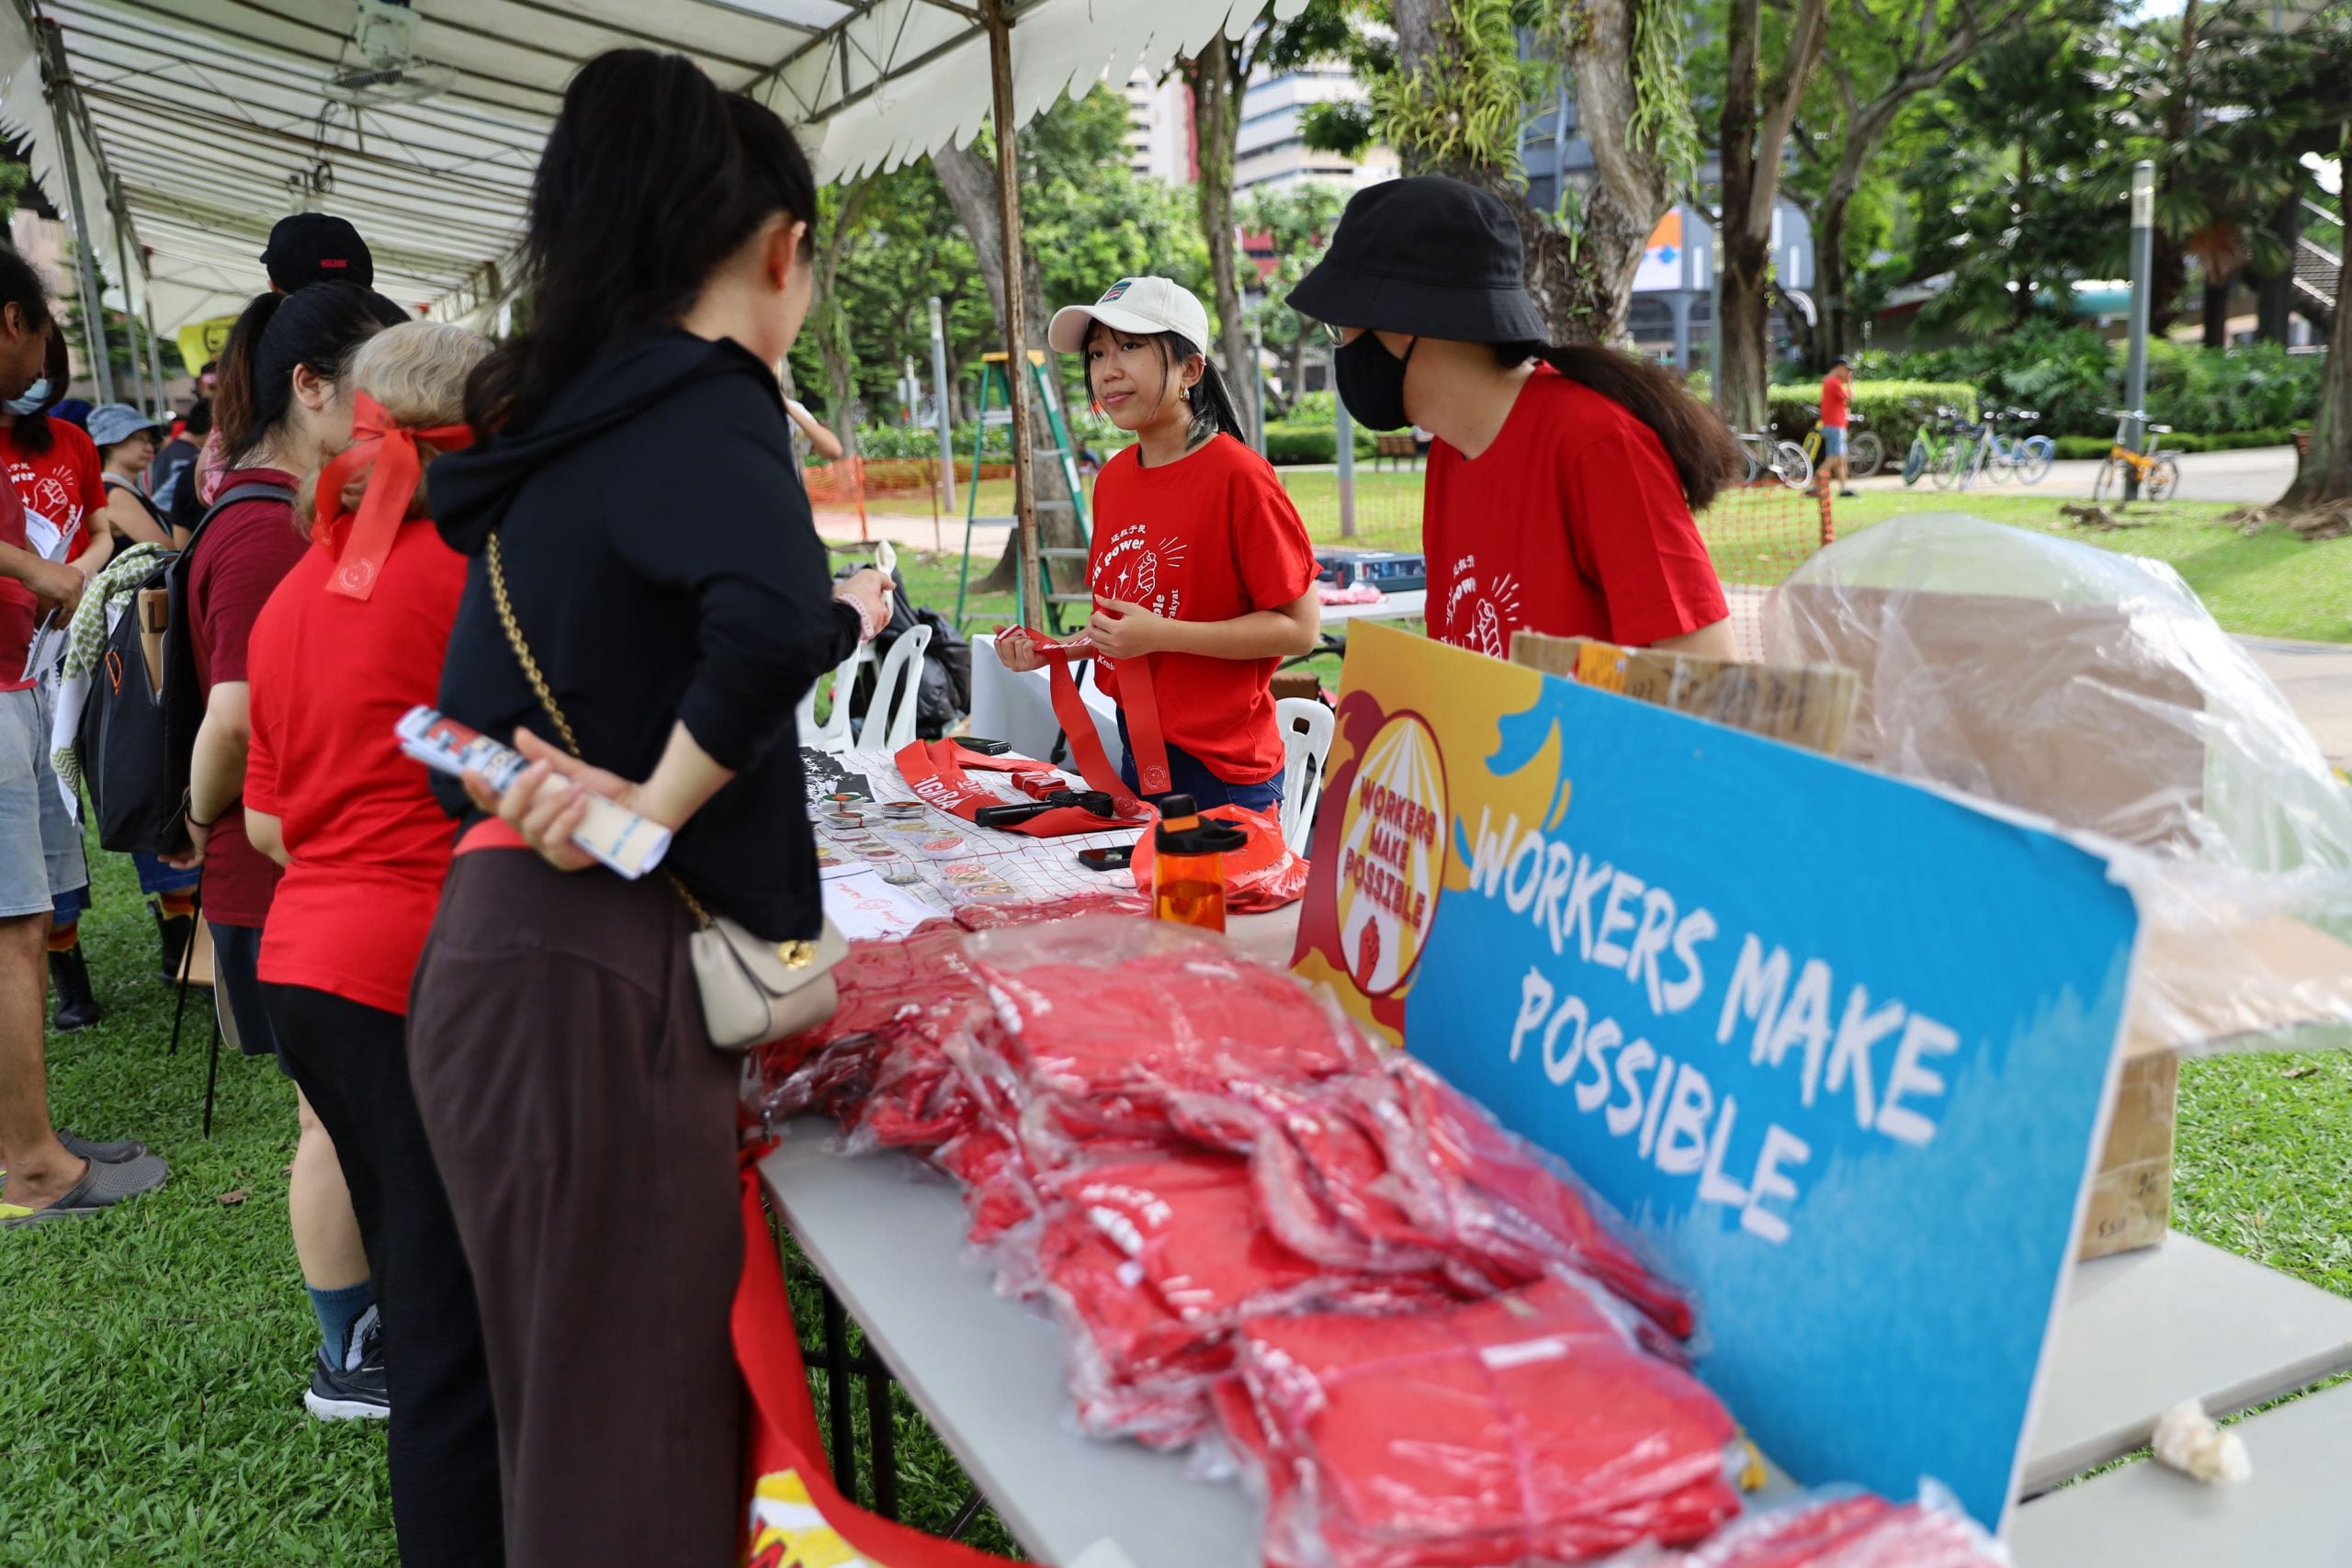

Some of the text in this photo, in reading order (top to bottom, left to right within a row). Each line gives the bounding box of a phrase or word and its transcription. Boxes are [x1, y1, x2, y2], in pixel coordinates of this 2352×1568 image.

[1360, 776, 1437, 846] WORKERS
[1369, 823, 1410, 872] MAKE
[1343, 847, 1426, 930] POSSIBLE
[1470, 805, 1961, 1145] WORKERS MAKE
[1510, 965, 1811, 1244] POSSIBLE
